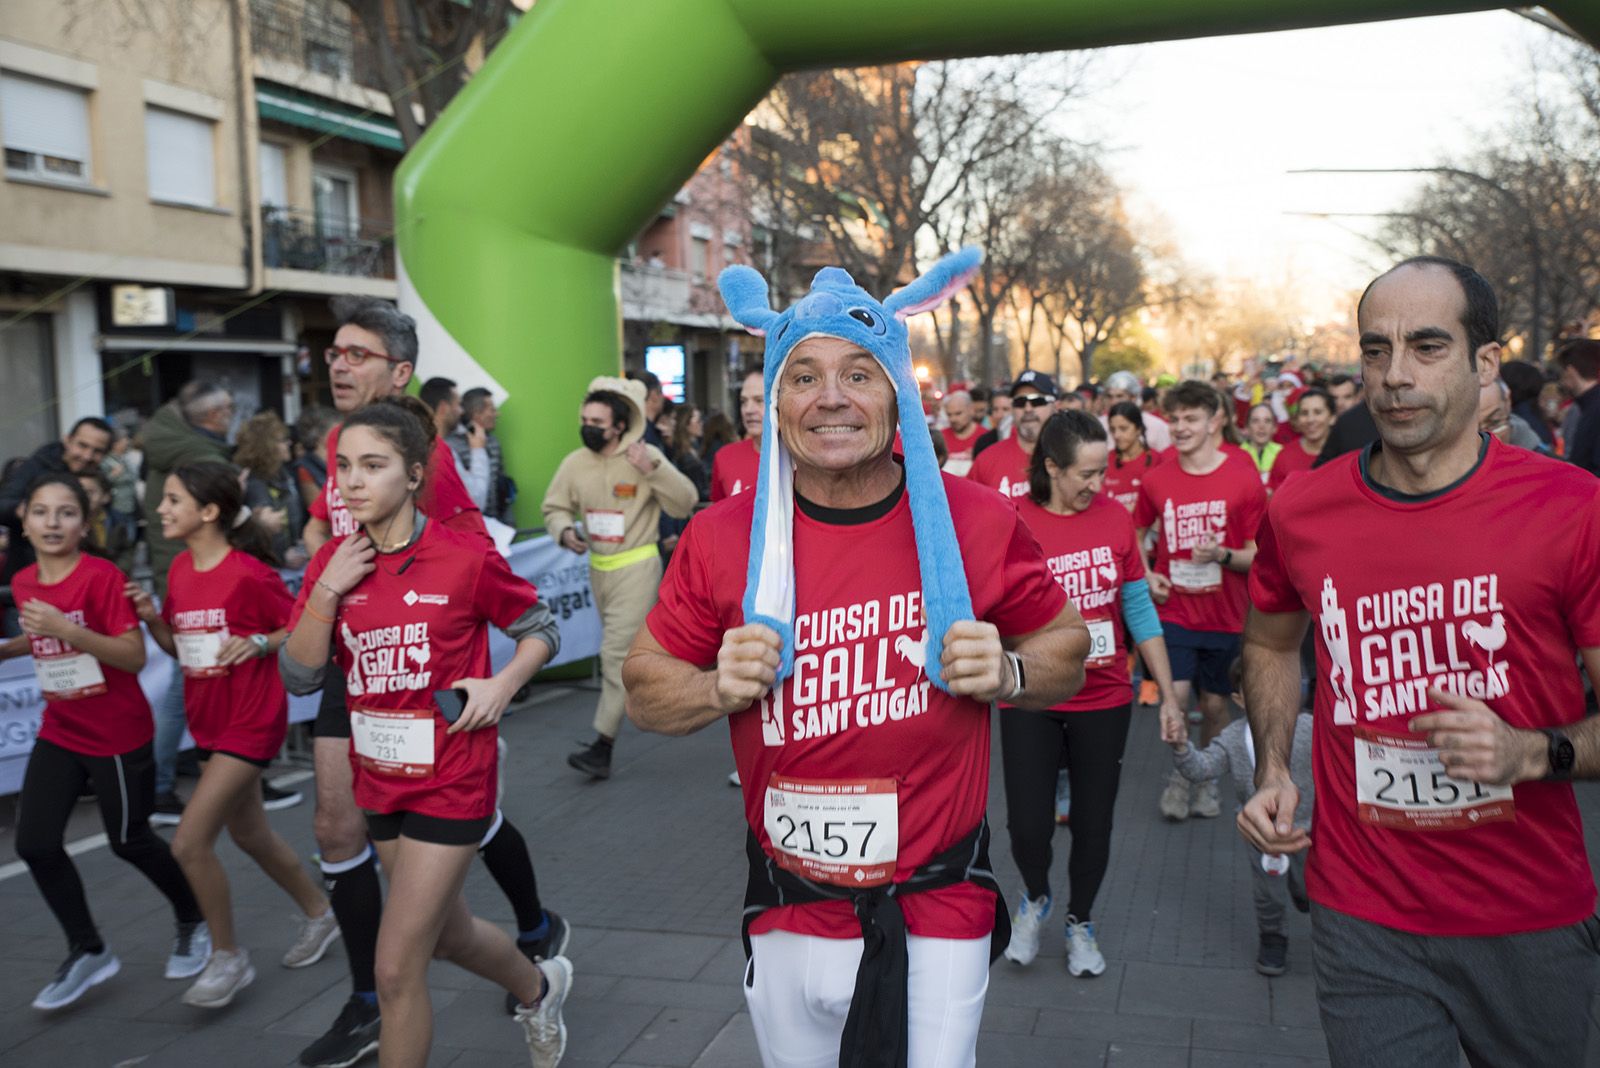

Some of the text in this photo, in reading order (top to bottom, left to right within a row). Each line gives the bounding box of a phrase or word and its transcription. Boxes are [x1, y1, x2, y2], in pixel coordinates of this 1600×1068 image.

[1047, 546, 1114, 574] CURSA DEL
[794, 599, 881, 651] CURSA
[1357, 573, 1504, 634] CURSA DEL
[357, 621, 430, 652] CURSA DEL
[1360, 622, 1471, 686] GALL
[360, 645, 411, 678] GALL
[388, 671, 432, 692] CUGAT
[792, 637, 896, 707] GALL
[792, 680, 931, 742] SANT CUGAT
[1363, 677, 1430, 722] SANT
[369, 731, 406, 747] SOFIA
[375, 746, 399, 760] 731
[776, 814, 878, 859] 2157
